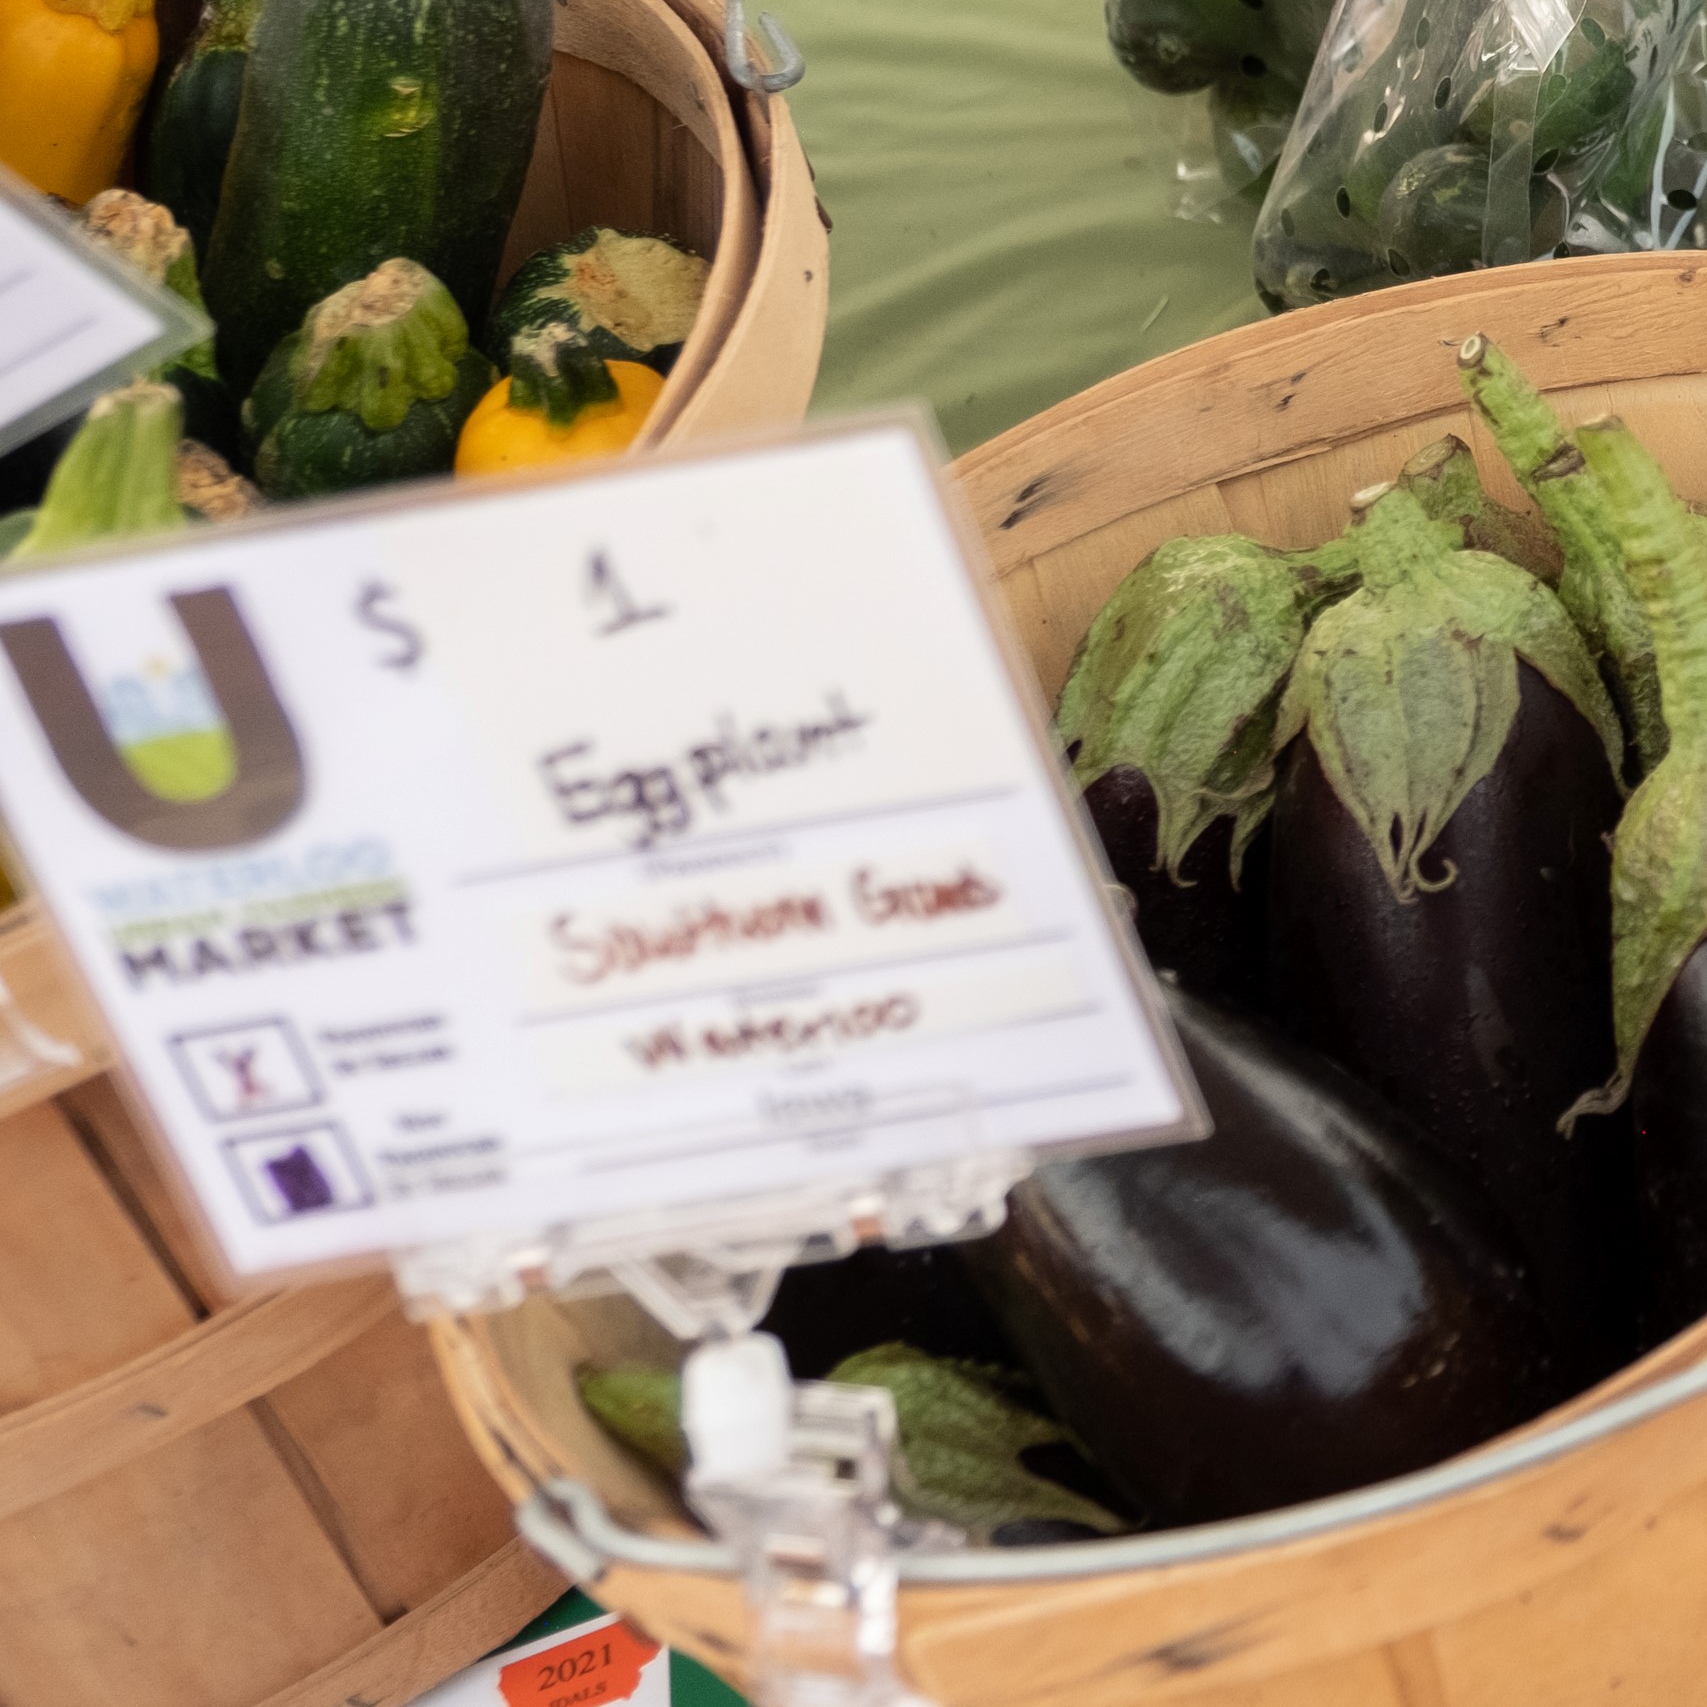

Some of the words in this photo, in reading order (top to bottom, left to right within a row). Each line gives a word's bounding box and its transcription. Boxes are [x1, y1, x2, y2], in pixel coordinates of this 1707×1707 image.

[355, 579, 426, 673] $
[578, 546, 674, 638] 1
[540, 692, 868, 851] Eggplant
[119, 896, 417, 992] MARKET
[537, 1643, 612, 1692] 2021
